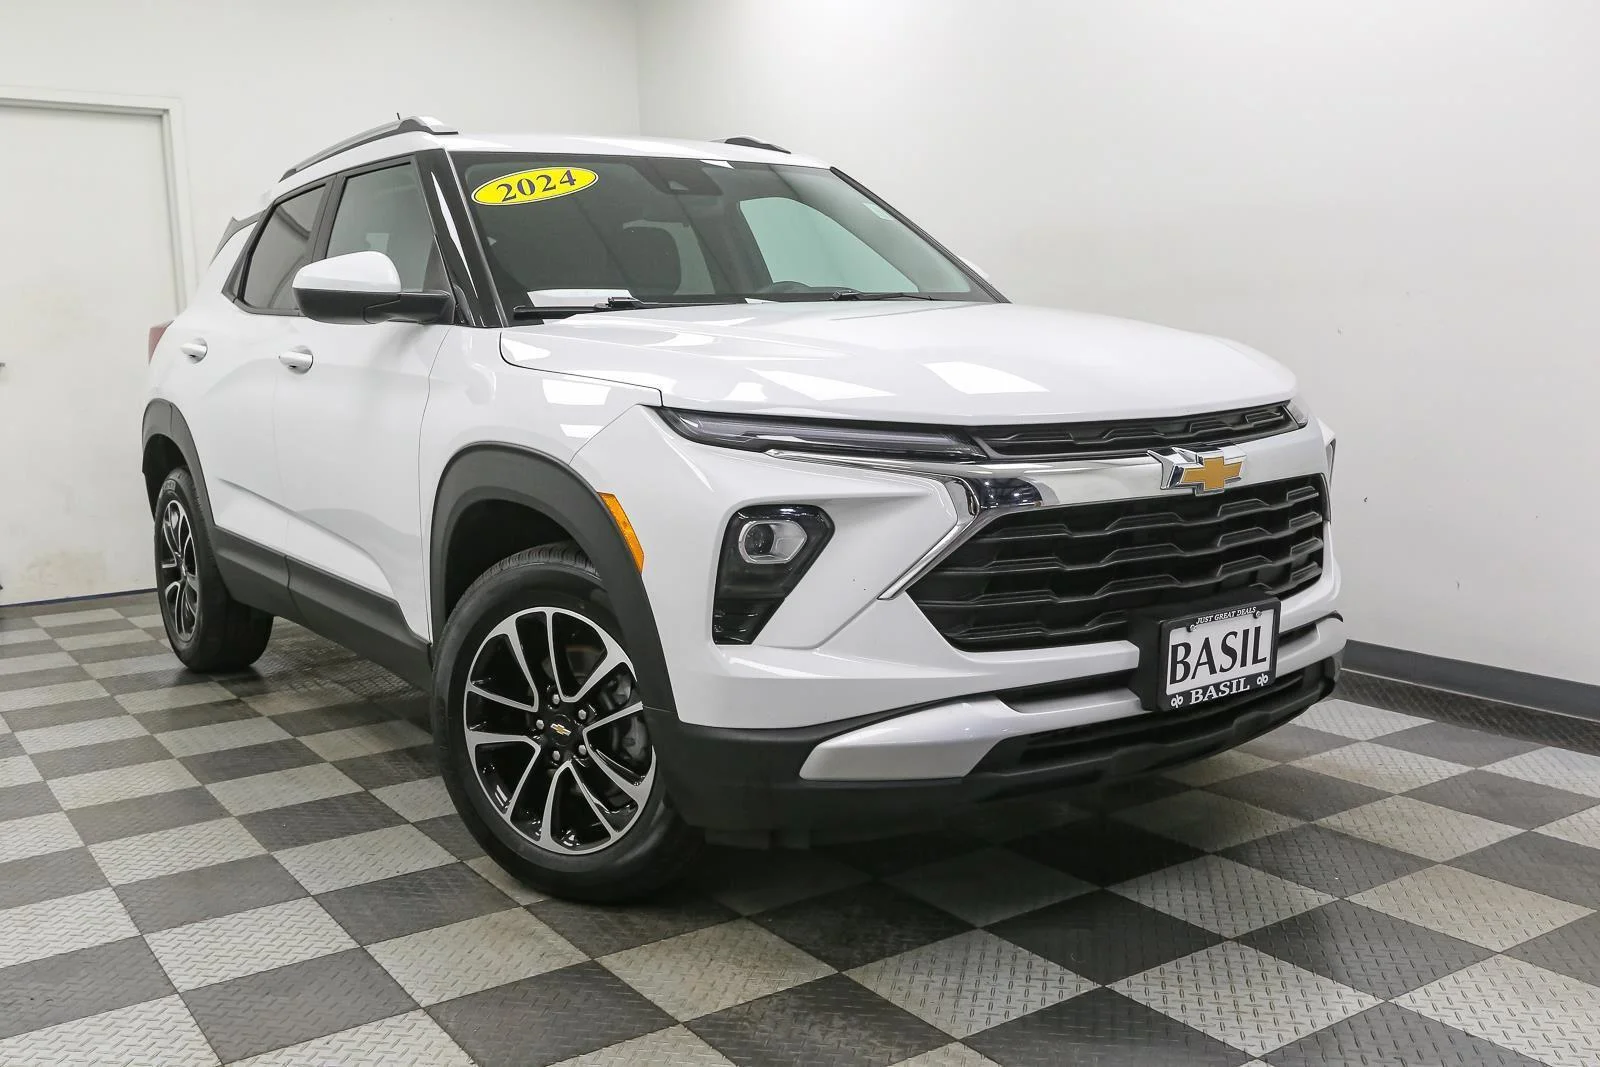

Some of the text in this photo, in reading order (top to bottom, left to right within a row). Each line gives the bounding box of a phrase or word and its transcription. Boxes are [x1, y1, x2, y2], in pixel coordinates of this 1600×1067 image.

[496, 169, 577, 202] 2024
[1195, 606, 1257, 625] JUST GREAT DEALS
[1169, 625, 1267, 685] BASIL
[1189, 677, 1250, 705] BASIL
